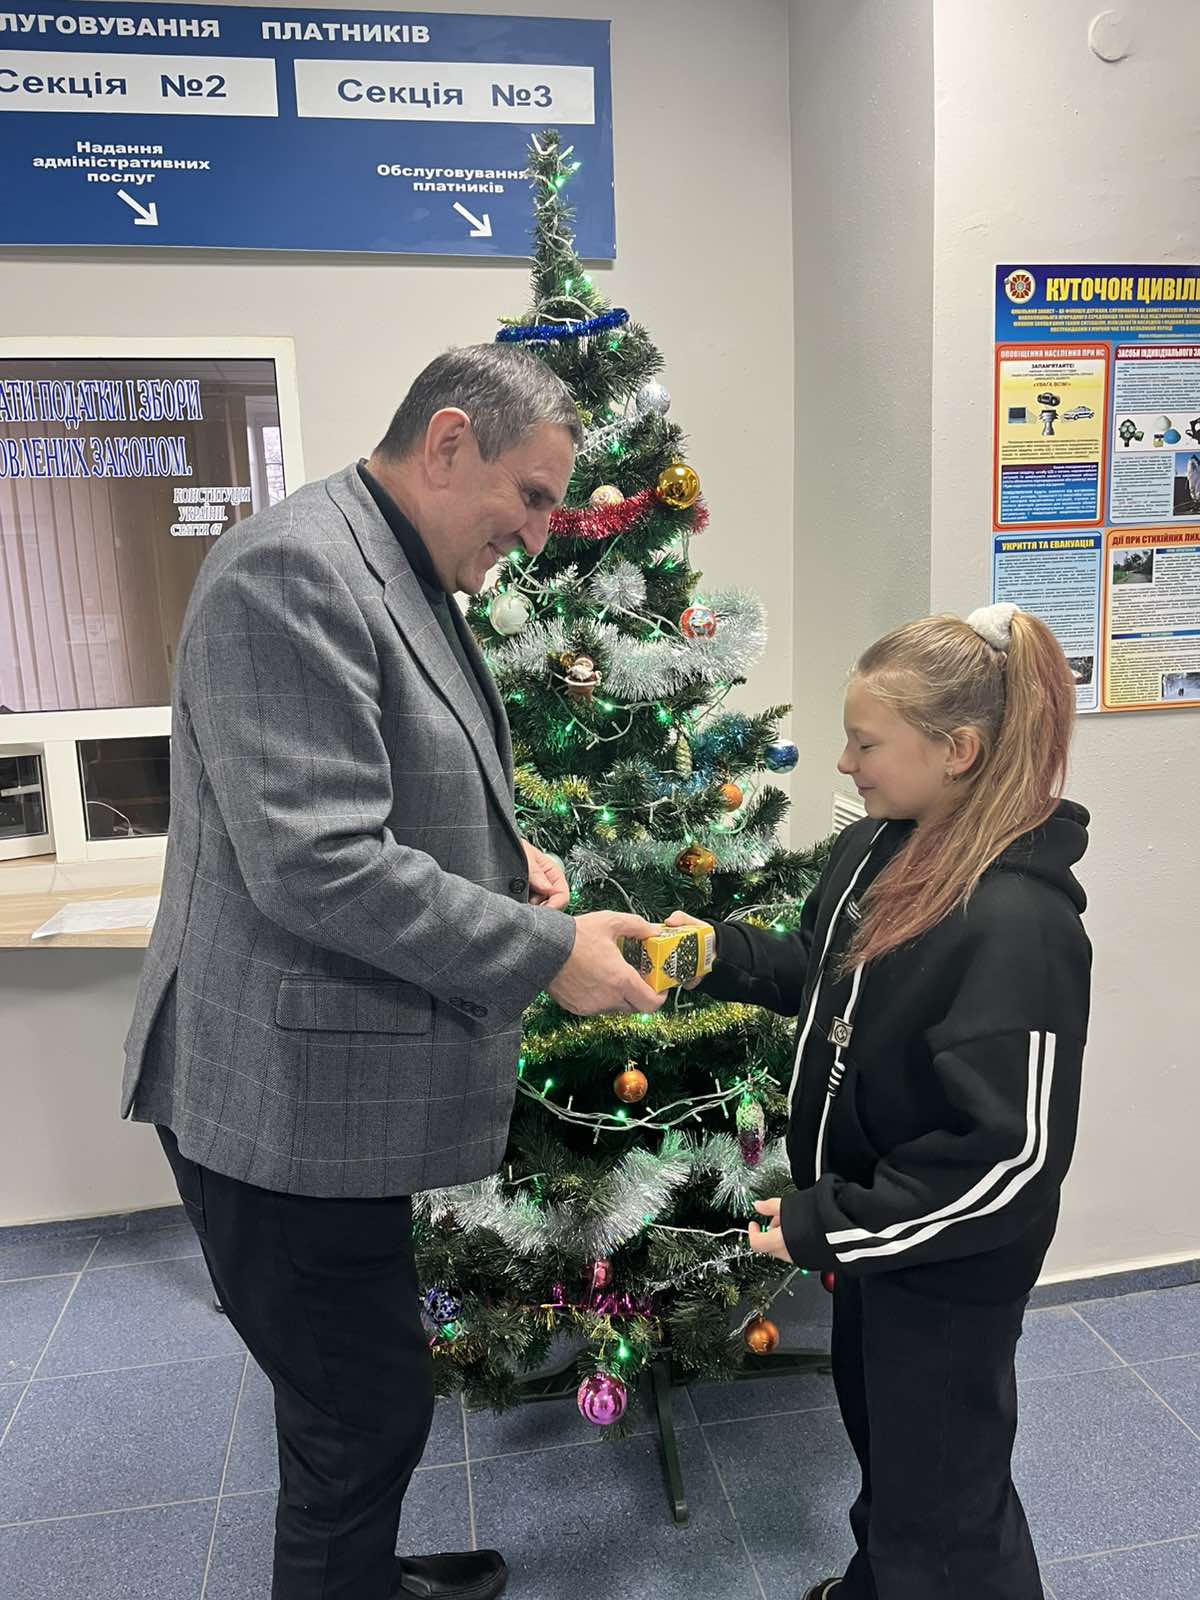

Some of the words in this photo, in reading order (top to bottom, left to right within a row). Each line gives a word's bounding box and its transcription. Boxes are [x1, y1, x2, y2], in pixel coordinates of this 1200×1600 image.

[261, 22, 430, 44] ПЛАТНИКІВ
[0, 68, 127, 98] Секція
[160, 74, 227, 98] №2
[337, 78, 463, 108] Секція
[491, 84, 553, 107] №3
[76, 141, 163, 154] Надання
[32, 156, 210, 170] адміністративних
[87, 171, 155, 185] послуг
[376, 164, 529, 179] Обслуговування
[413, 182, 504, 193] платників
[1046, 277, 1134, 302] КУТОЧОК
[37, 380, 126, 430] ПОДАТКИ
[137, 379, 203, 421] ЗБОРИ
[90, 436, 192, 478] ЗАКОНОМ.
[1002, 541, 1037, 551] УКРИТТЯ
[1038, 541, 1049, 549] ТА
[1049, 539, 1095, 549] ЕВАКУАЦІЯ
[1125, 535, 1141, 544] ПРИ
